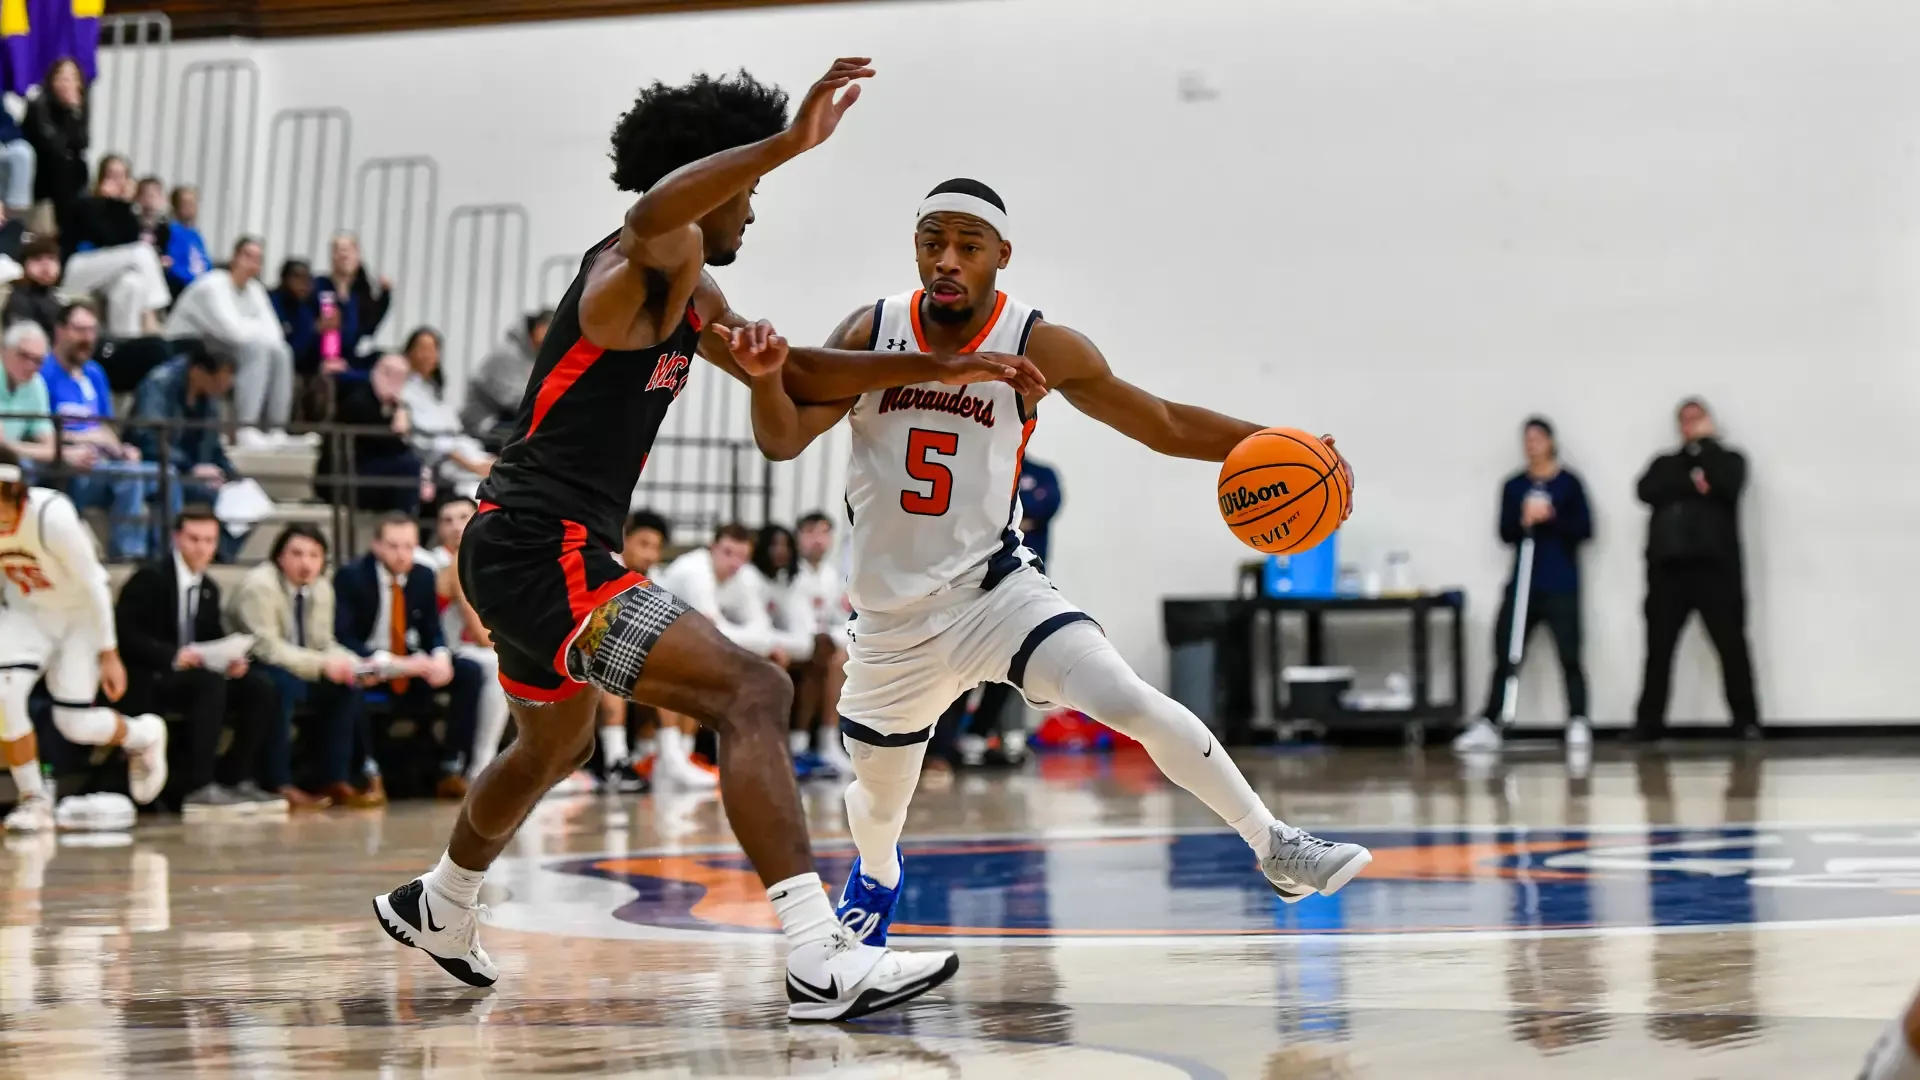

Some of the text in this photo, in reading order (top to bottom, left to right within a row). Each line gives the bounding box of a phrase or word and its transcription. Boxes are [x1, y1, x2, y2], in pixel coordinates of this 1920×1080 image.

[878, 384, 996, 428] Marauders
[900, 427, 959, 516] 5
[1219, 481, 1290, 517] Wilson
